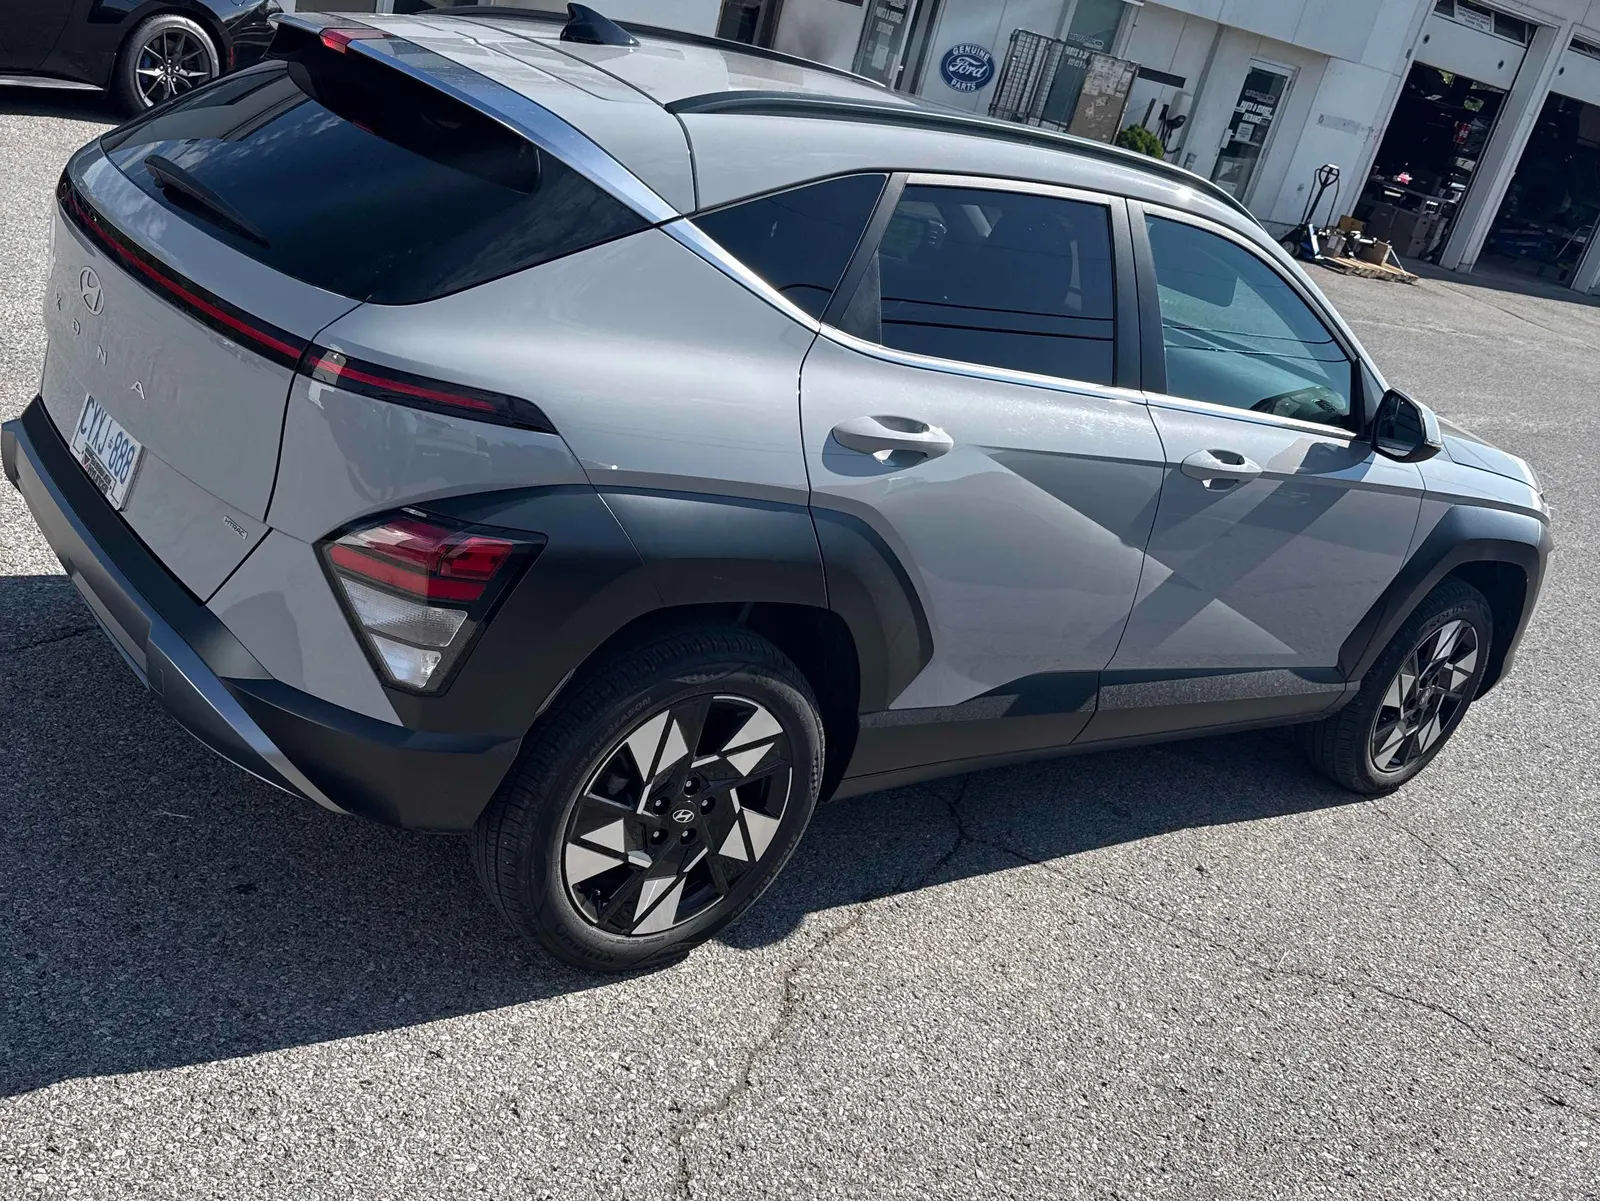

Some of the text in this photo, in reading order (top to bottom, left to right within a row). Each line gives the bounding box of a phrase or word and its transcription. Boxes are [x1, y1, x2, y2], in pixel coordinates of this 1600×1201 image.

[952, 45, 990, 62] GENUINE
[949, 56, 987, 78] Ford
[951, 79, 976, 91] PARTS
[80, 395, 113, 455] CYXJ
[108, 431, 136, 485] 888
[224, 517, 246, 538] HTRAC
